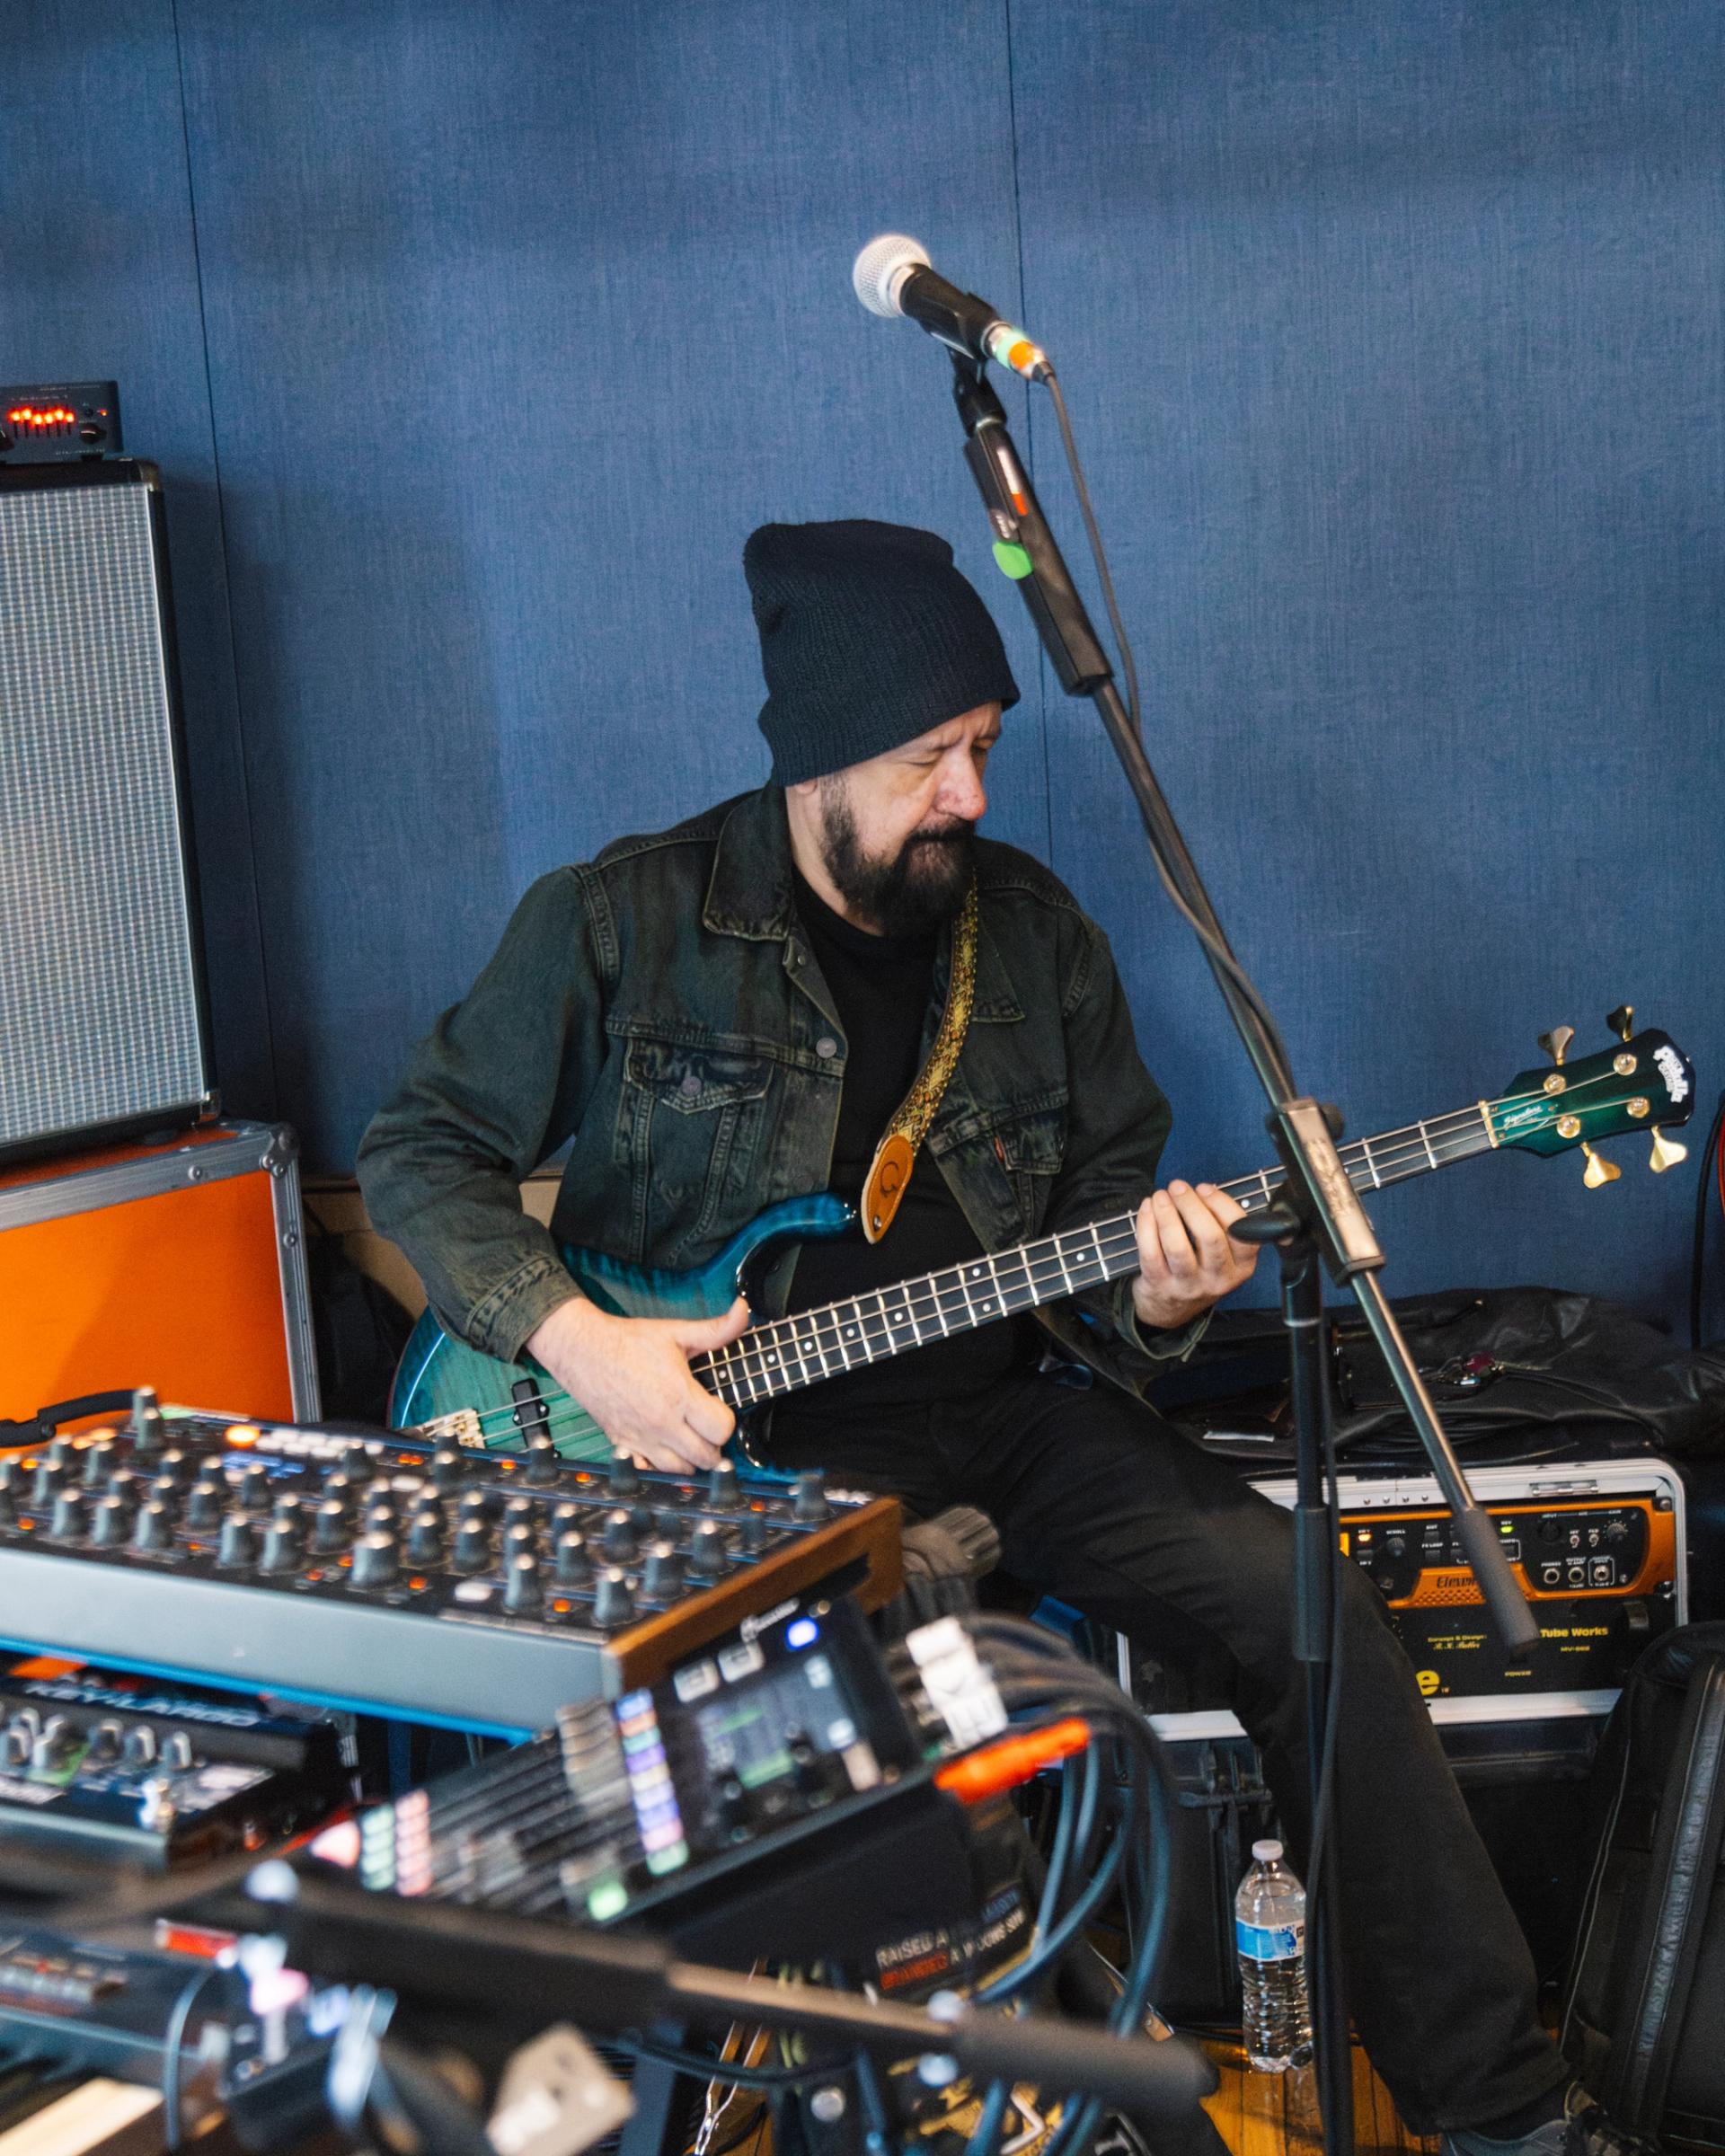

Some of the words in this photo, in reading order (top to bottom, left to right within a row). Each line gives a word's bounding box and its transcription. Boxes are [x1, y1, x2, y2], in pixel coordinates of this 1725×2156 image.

[1540, 1629, 1570, 1638] Tube
[1571, 1627, 1609, 1637] Works
[875, 1931, 934, 1969] RAISED
